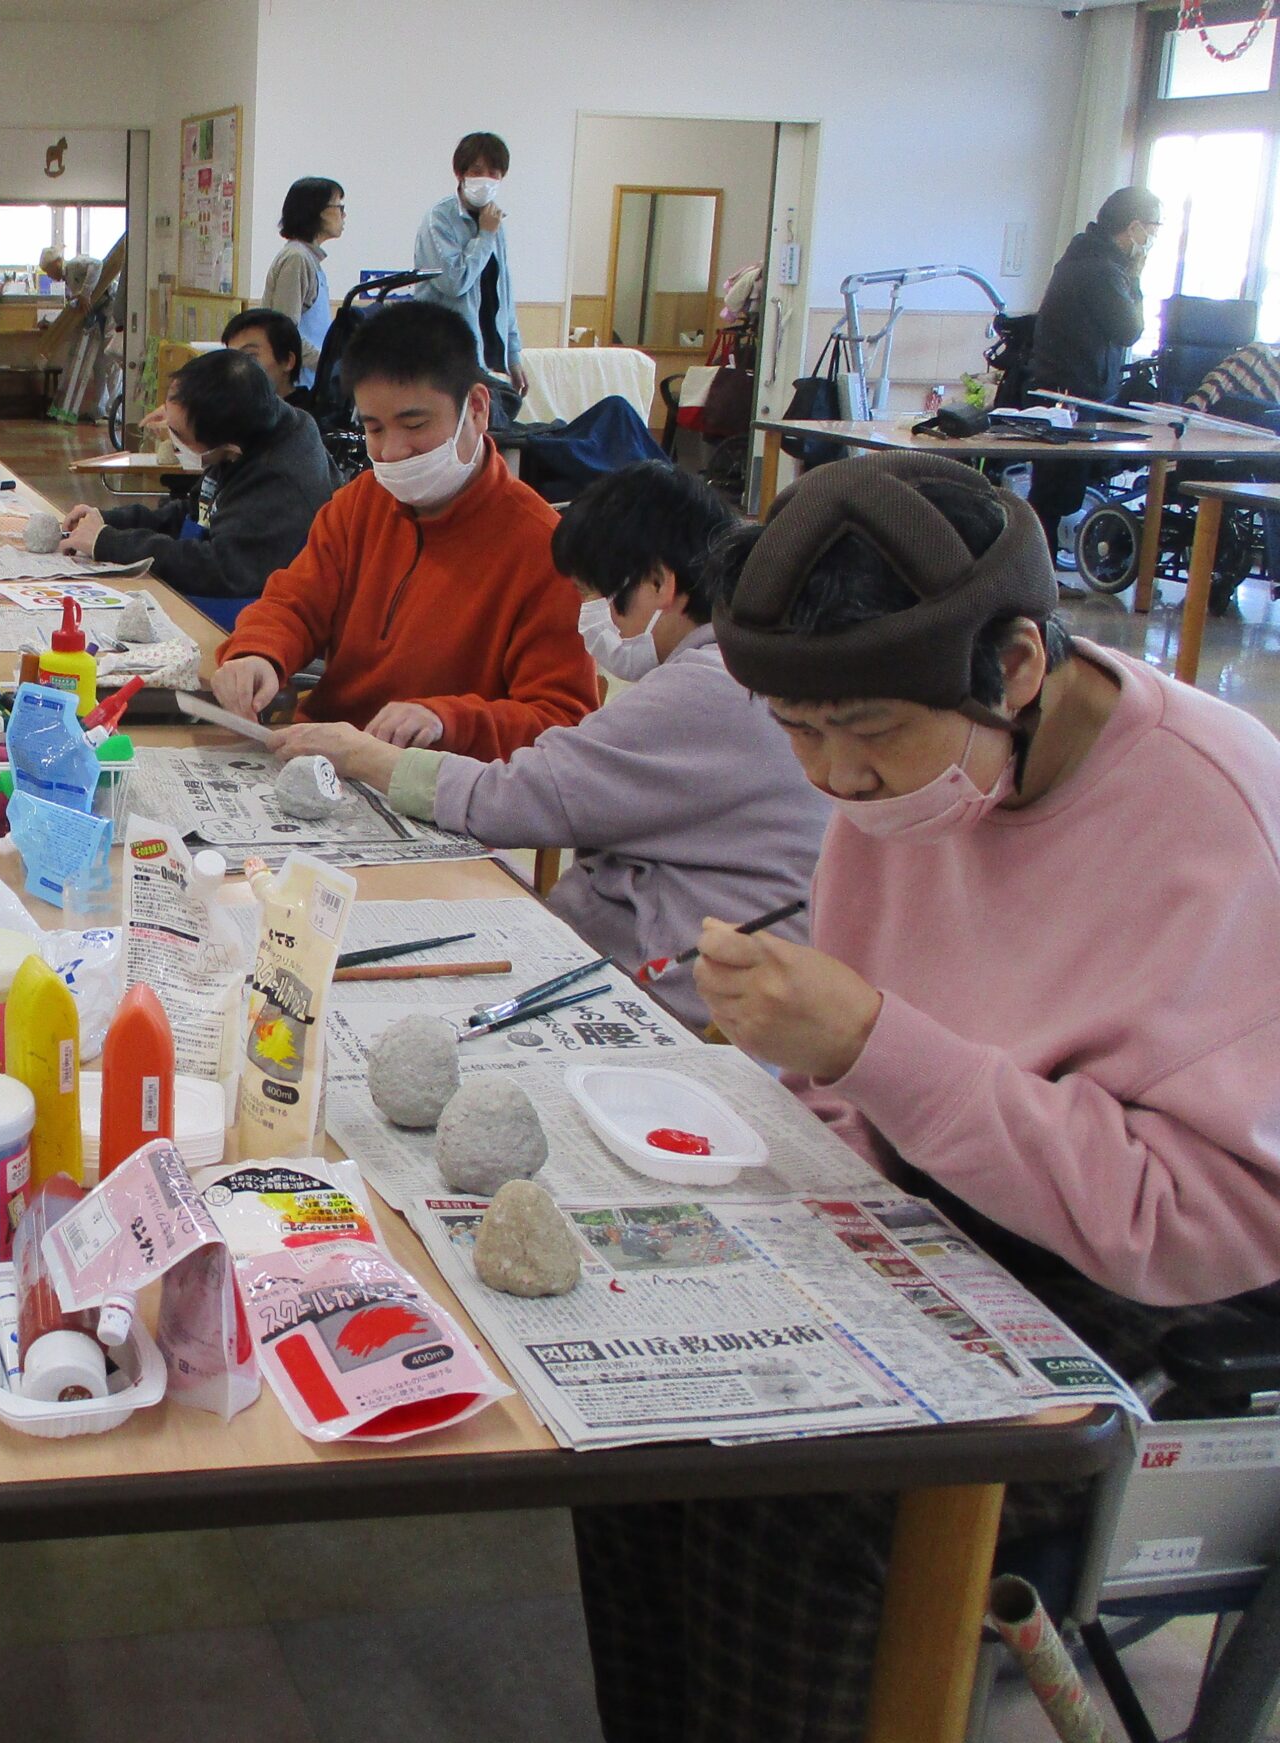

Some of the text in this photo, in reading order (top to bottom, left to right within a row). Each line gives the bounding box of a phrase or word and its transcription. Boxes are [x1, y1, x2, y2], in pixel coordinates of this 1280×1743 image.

[411, 1349, 447, 1366] 400ml
[535, 1325, 825, 1363] 図解 山岳救助技術
